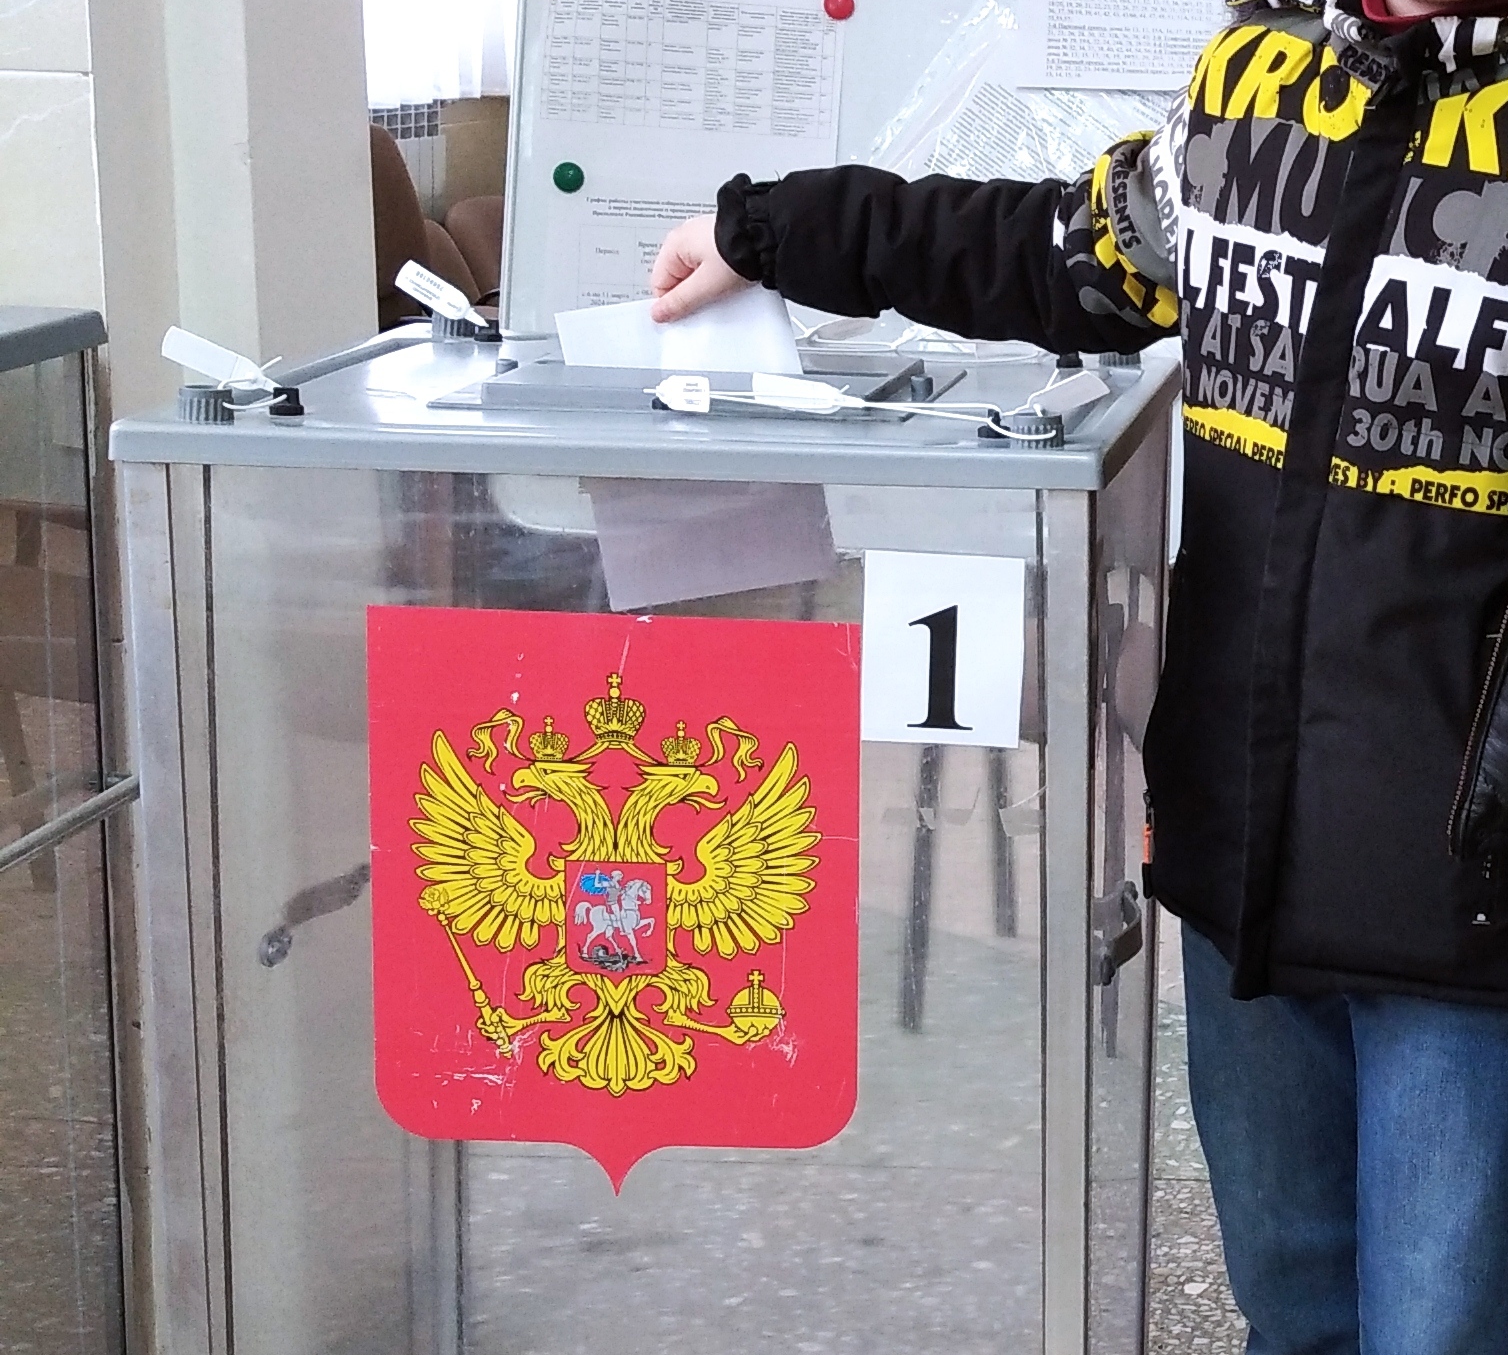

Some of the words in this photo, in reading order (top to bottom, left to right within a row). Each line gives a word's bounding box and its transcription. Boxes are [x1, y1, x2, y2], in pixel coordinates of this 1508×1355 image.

[1198, 363, 1296, 430] NOVEM
[1346, 408, 1444, 461] 30th
[1409, 477, 1480, 509] PERFO
[907, 605, 973, 731] 1
